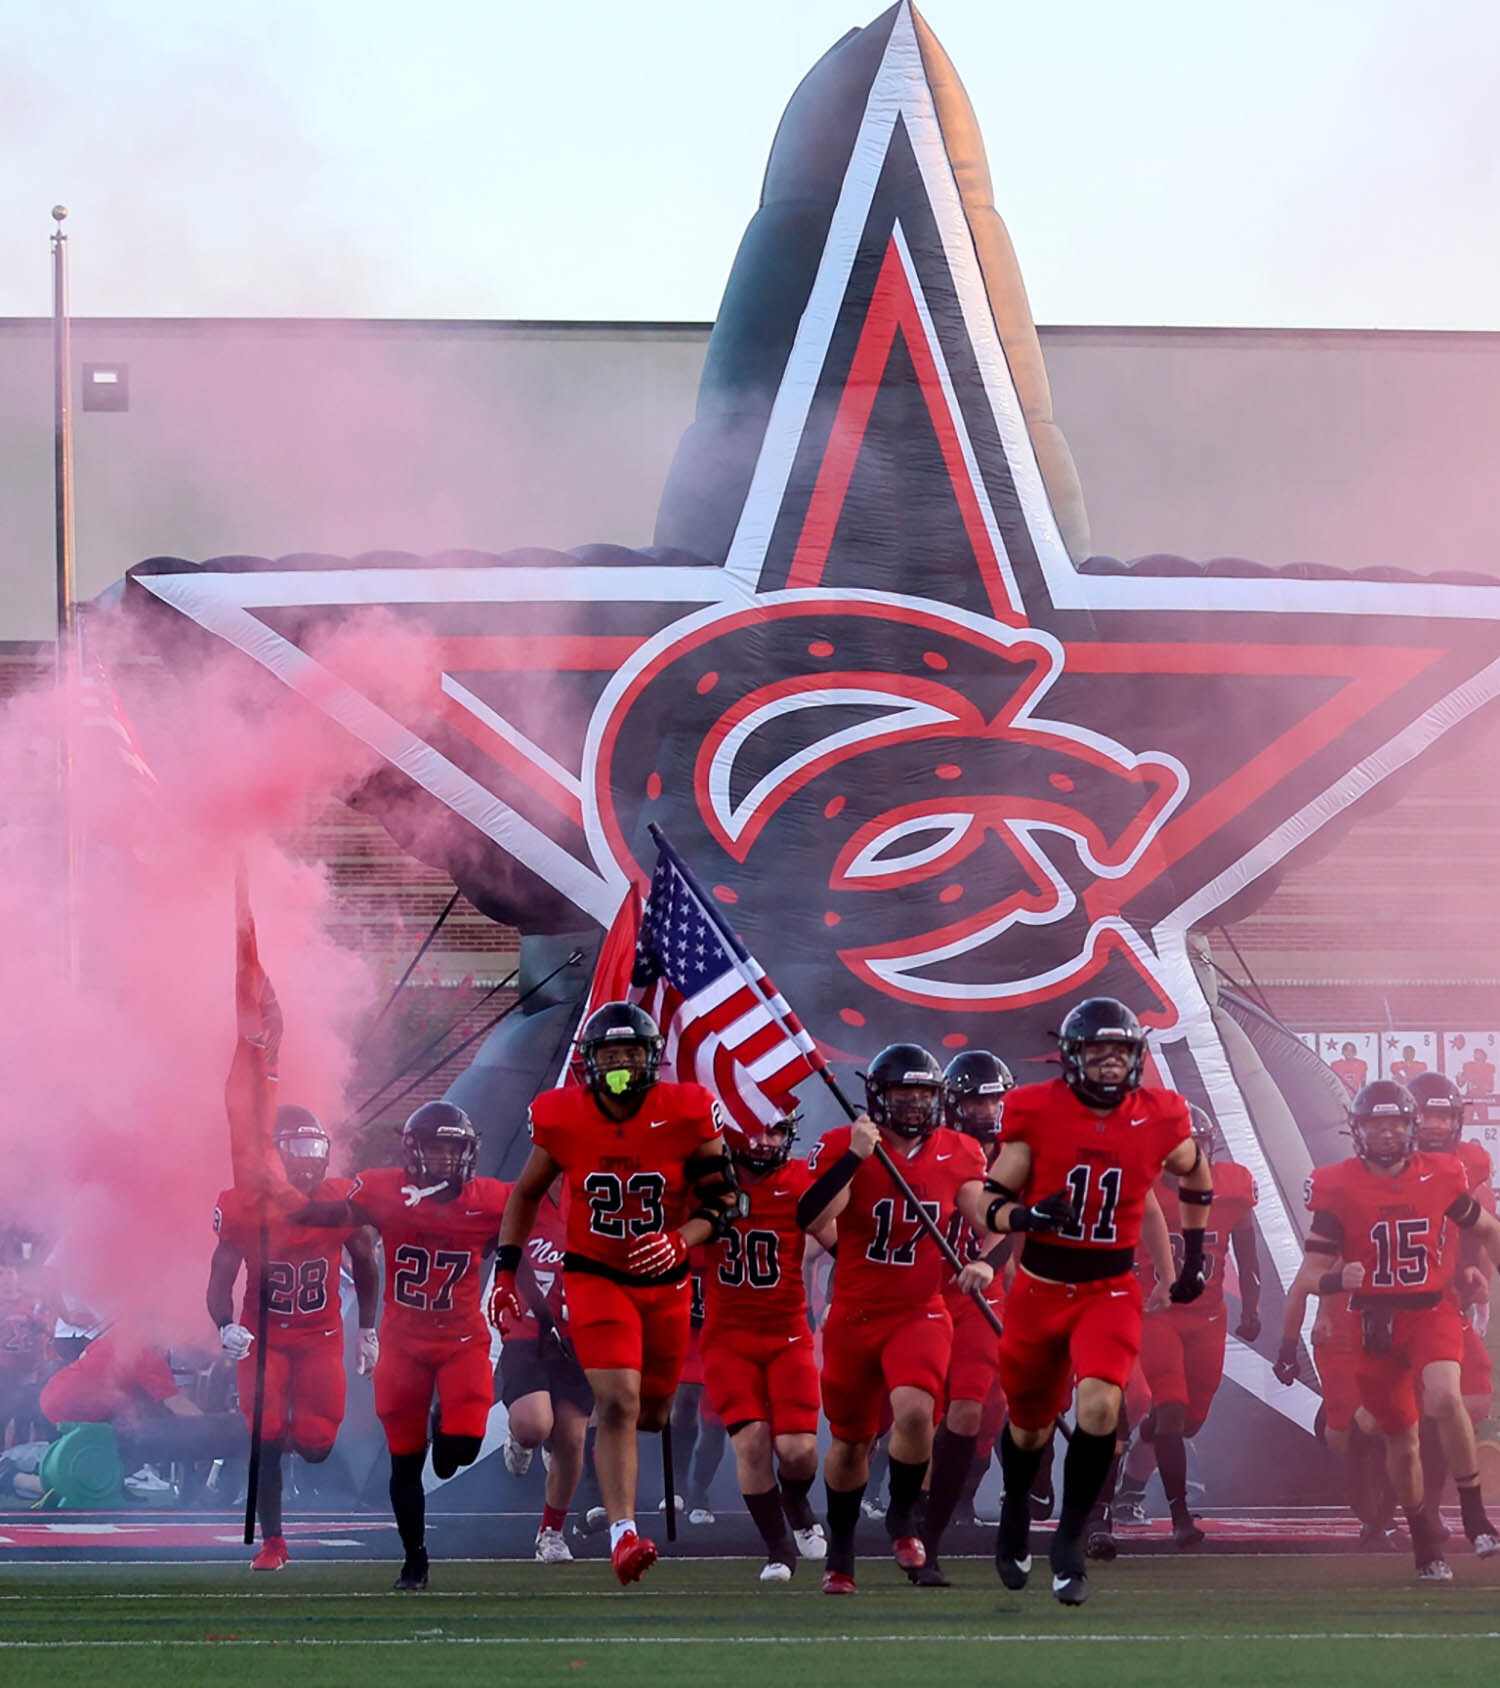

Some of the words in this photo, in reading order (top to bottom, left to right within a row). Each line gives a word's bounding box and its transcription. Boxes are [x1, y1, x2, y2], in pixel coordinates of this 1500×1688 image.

[584, 1172, 666, 1239] 23
[865, 1198, 941, 1266] 17
[1058, 1164, 1122, 1242] 11
[267, 1257, 328, 1315] 28
[395, 1244, 471, 1311] 27
[718, 1226, 781, 1288] 30
[1371, 1218, 1430, 1288] 15
